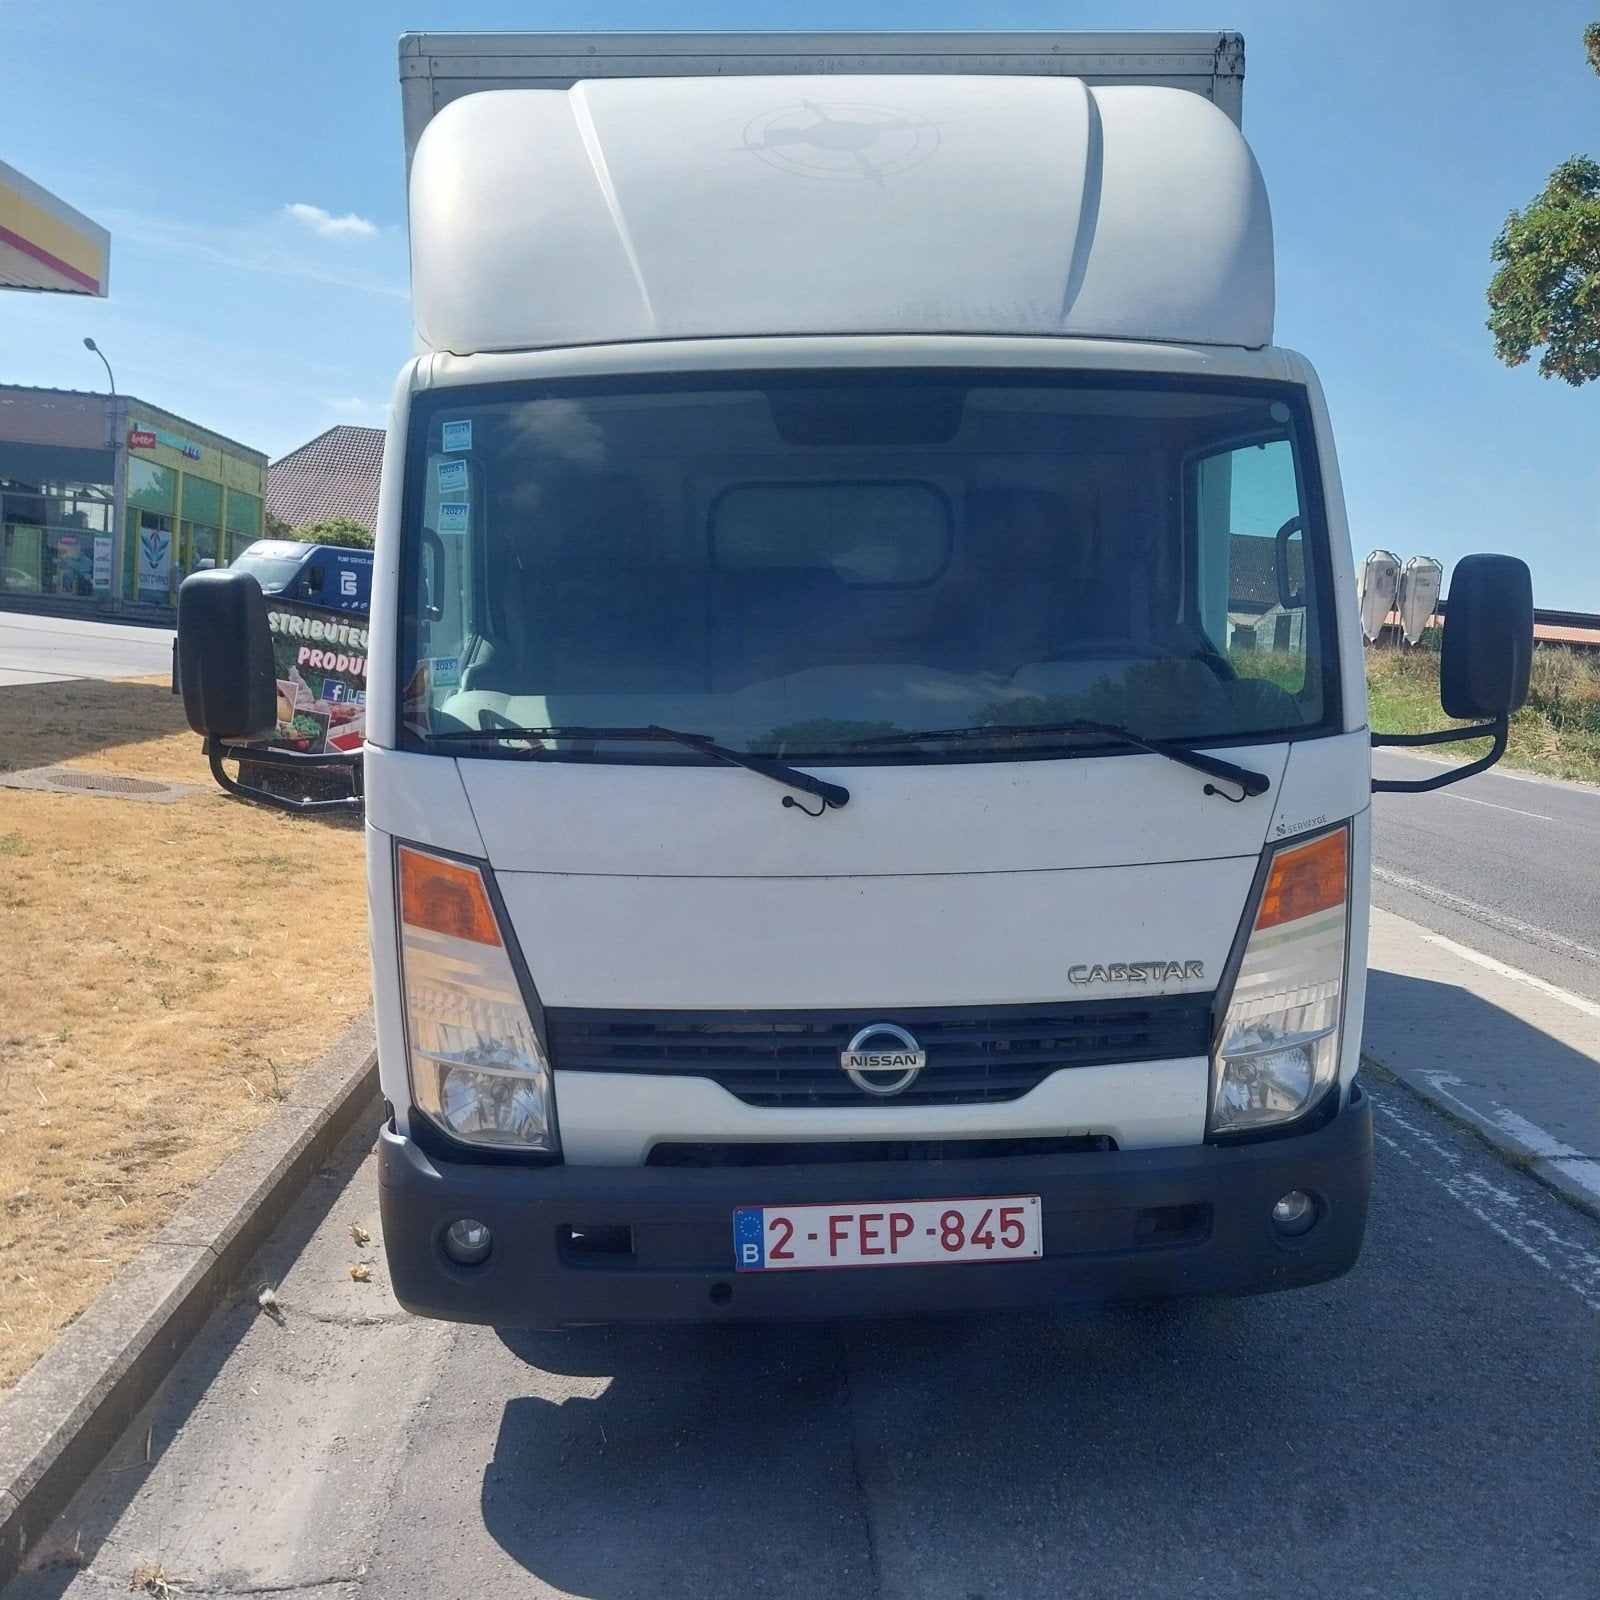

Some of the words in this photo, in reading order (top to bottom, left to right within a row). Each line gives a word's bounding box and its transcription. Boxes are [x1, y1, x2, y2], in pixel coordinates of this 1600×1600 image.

[436, 662, 454, 671] 2025
[1287, 814, 1327, 834] SERVAYGE
[1067, 960, 1205, 983] CABSTAR
[850, 1054, 917, 1067] NISSAN
[742, 1243, 760, 1263] B
[768, 1206, 1026, 1260] 2-FEP-845
